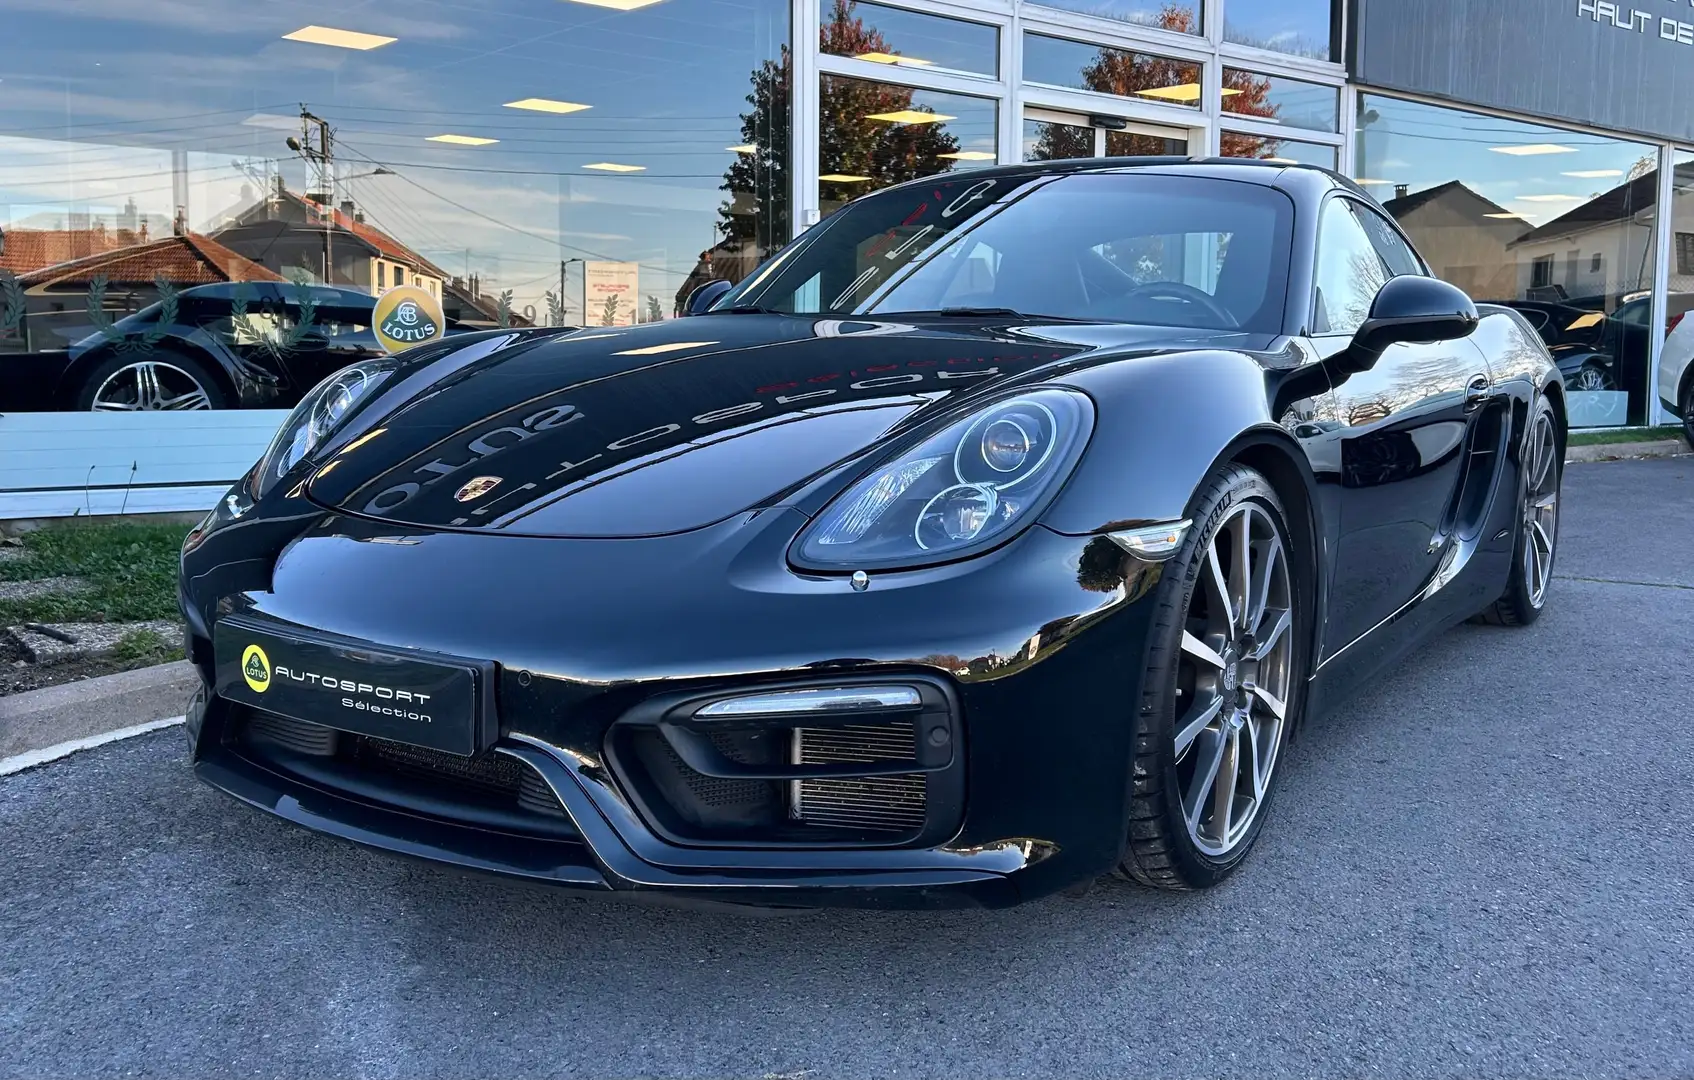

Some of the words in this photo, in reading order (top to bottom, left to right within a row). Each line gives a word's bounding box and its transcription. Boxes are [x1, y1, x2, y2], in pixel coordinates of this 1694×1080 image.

[1577, 0, 1652, 33] HAUT
[382, 322, 436, 341] LOTUS
[1195, 491, 1232, 560] MICHELIN
[246, 667, 267, 680] LOTUS
[275, 665, 431, 705] AUTOSPORT
[341, 697, 432, 723] Sélection
